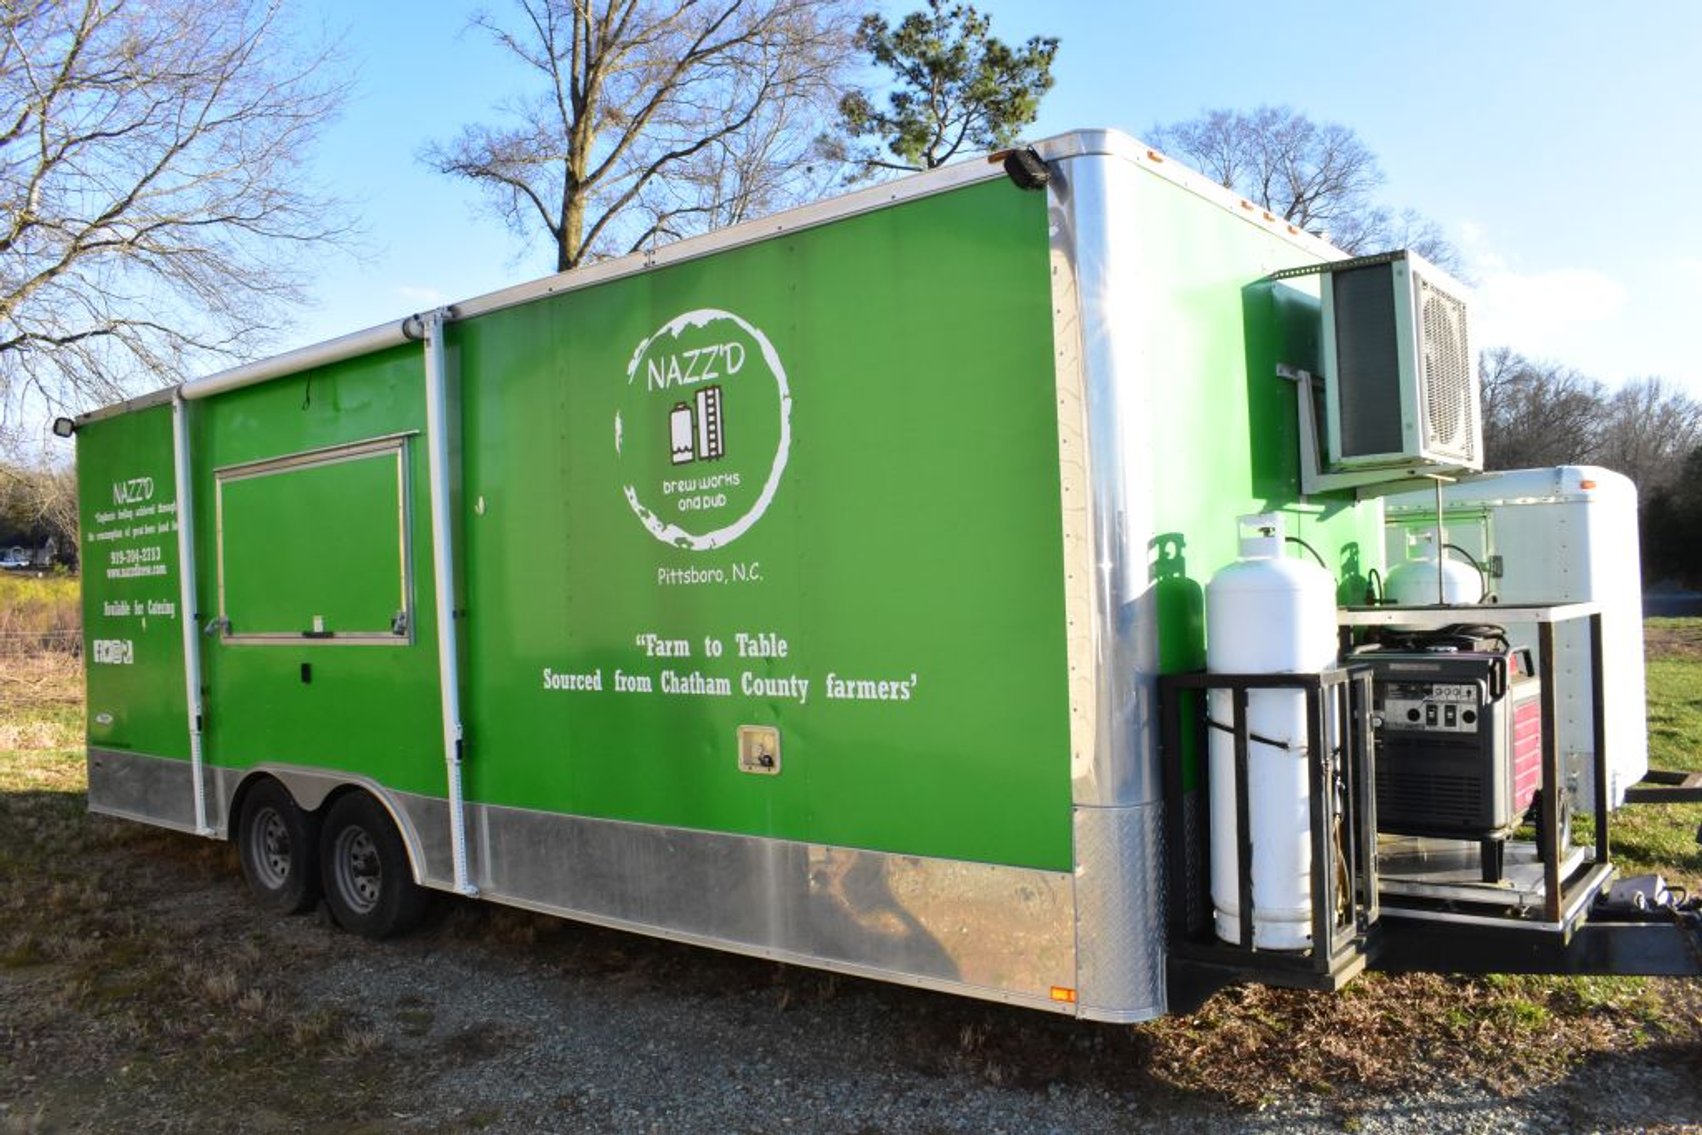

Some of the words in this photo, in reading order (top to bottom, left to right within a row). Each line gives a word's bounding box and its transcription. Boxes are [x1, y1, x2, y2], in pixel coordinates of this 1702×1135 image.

[647, 341, 746, 391] NAZZ'D
[663, 480, 696, 494] brew
[698, 473, 741, 490] works
[678, 496, 701, 511] and
[702, 493, 727, 510] pub
[658, 565, 729, 585] Pittsboro,
[732, 561, 764, 581] N.C.
[704, 635, 723, 657] to
[735, 632, 788, 658] Table
[543, 667, 603, 691] Sourced
[614, 669, 653, 693] from
[661, 670, 731, 696] Chatham
[741, 671, 810, 704] County
